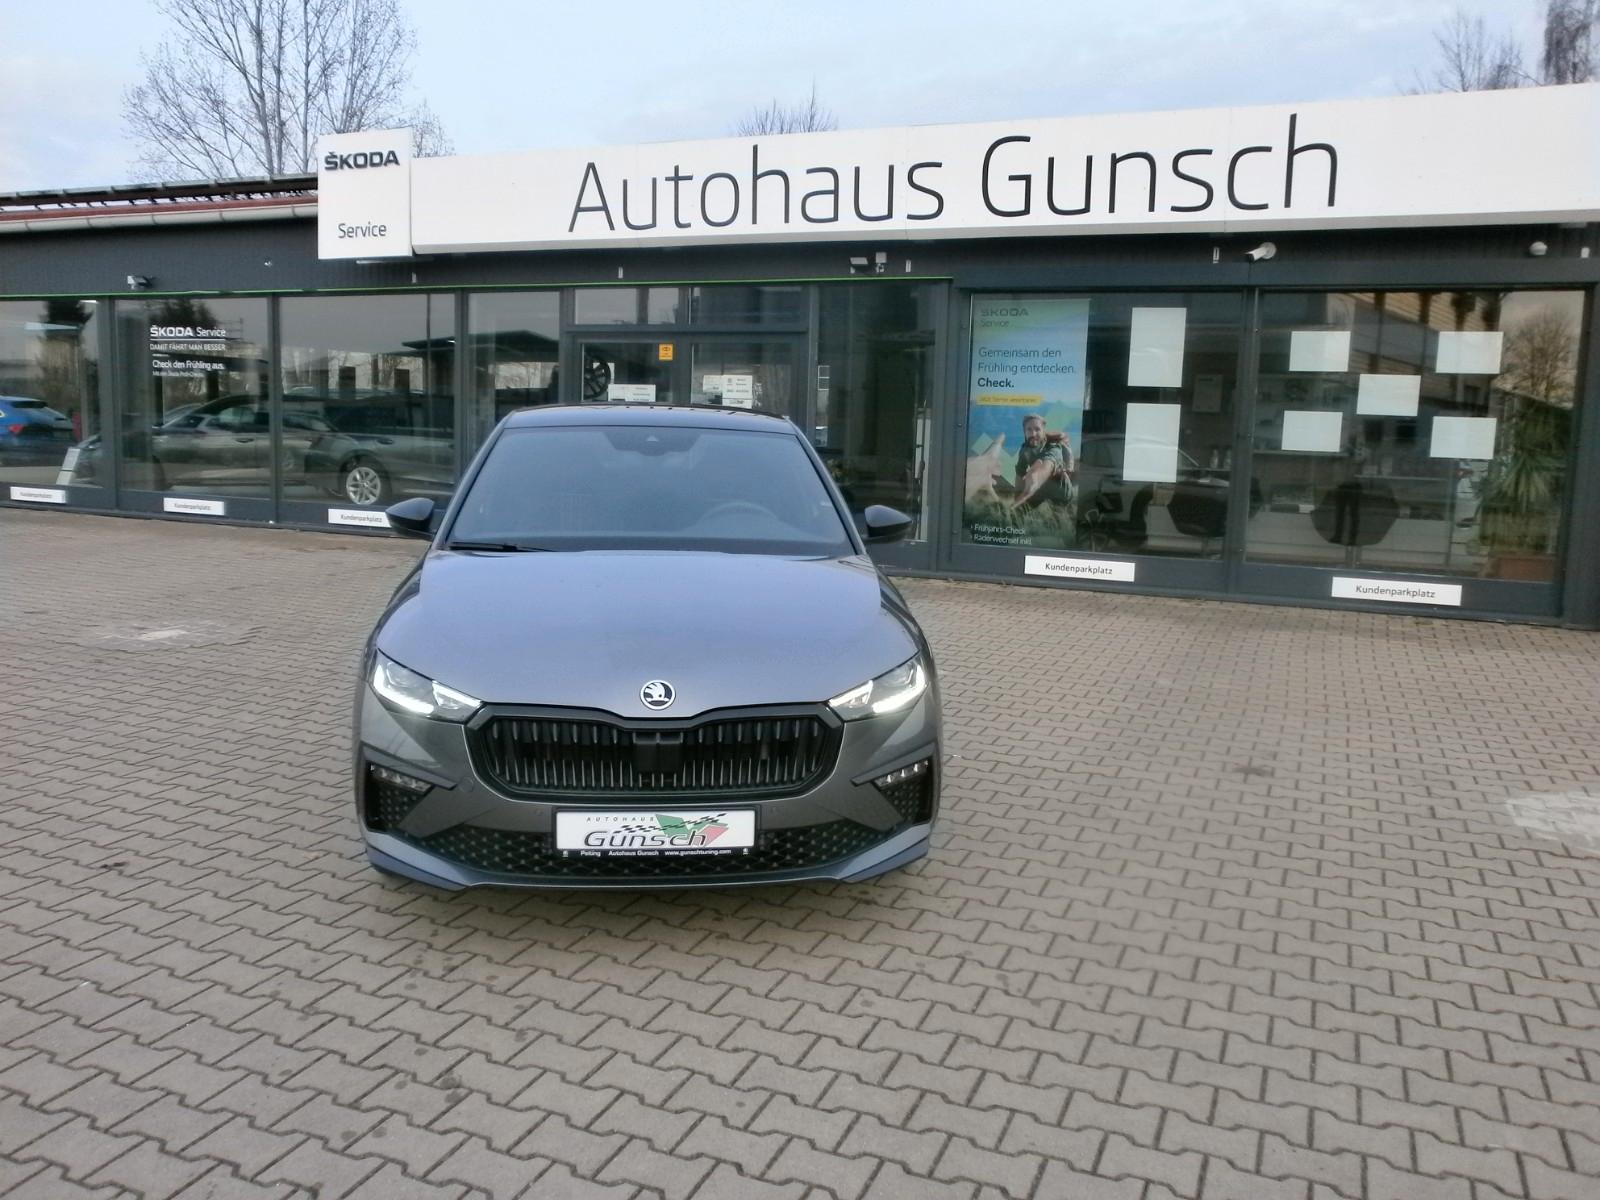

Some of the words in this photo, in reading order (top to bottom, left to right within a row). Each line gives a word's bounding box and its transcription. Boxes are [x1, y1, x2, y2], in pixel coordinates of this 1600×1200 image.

[324, 150, 400, 171] ŠKODA
[568, 144, 945, 233] Autohaus
[981, 113, 1338, 217] Gunsch
[338, 221, 387, 239] Service
[150, 325, 194, 337] ŠKODA
[196, 326, 226, 337] Service
[188, 343, 203, 351] MAN
[203, 343, 226, 351] BESSER
[978, 347, 1039, 358] Gemeinsam
[1041, 347, 1062, 358] den
[152, 360, 172, 369] Check
[173, 360, 185, 369] den
[977, 377, 1015, 388] Check.
[1045, 563, 1113, 575] Kundenparkplatz
[1355, 585, 1436, 598] Kundenparkplatz
[584, 830, 706, 847] Gunsch
